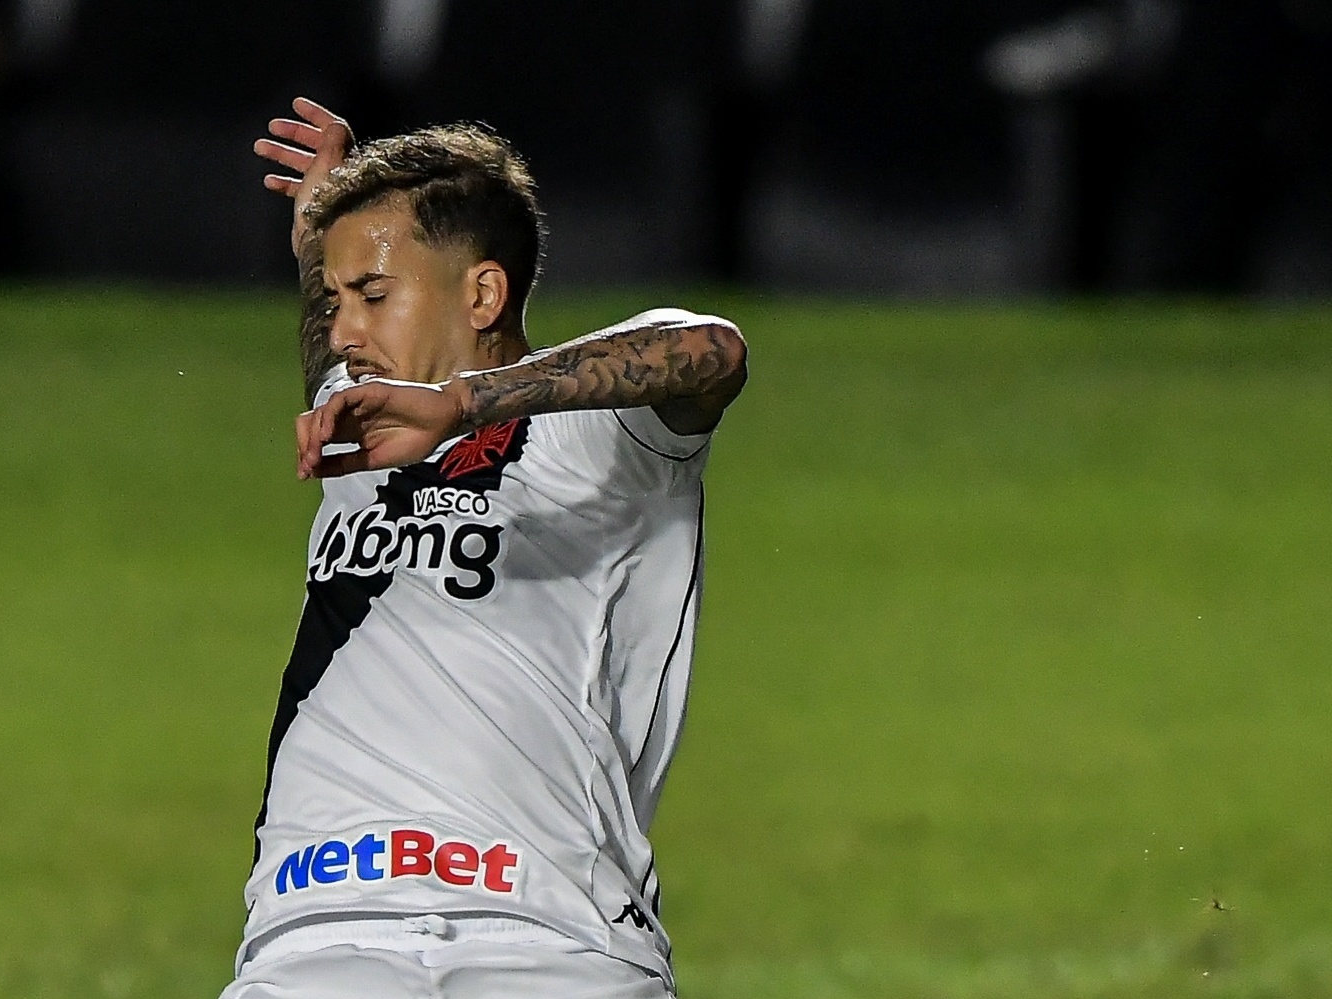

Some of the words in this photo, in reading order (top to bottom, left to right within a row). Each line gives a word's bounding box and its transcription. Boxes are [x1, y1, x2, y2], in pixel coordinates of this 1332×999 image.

[414, 488, 490, 516] VASCO
[344, 510, 505, 601] bmg
[275, 829, 518, 896] NetBet
